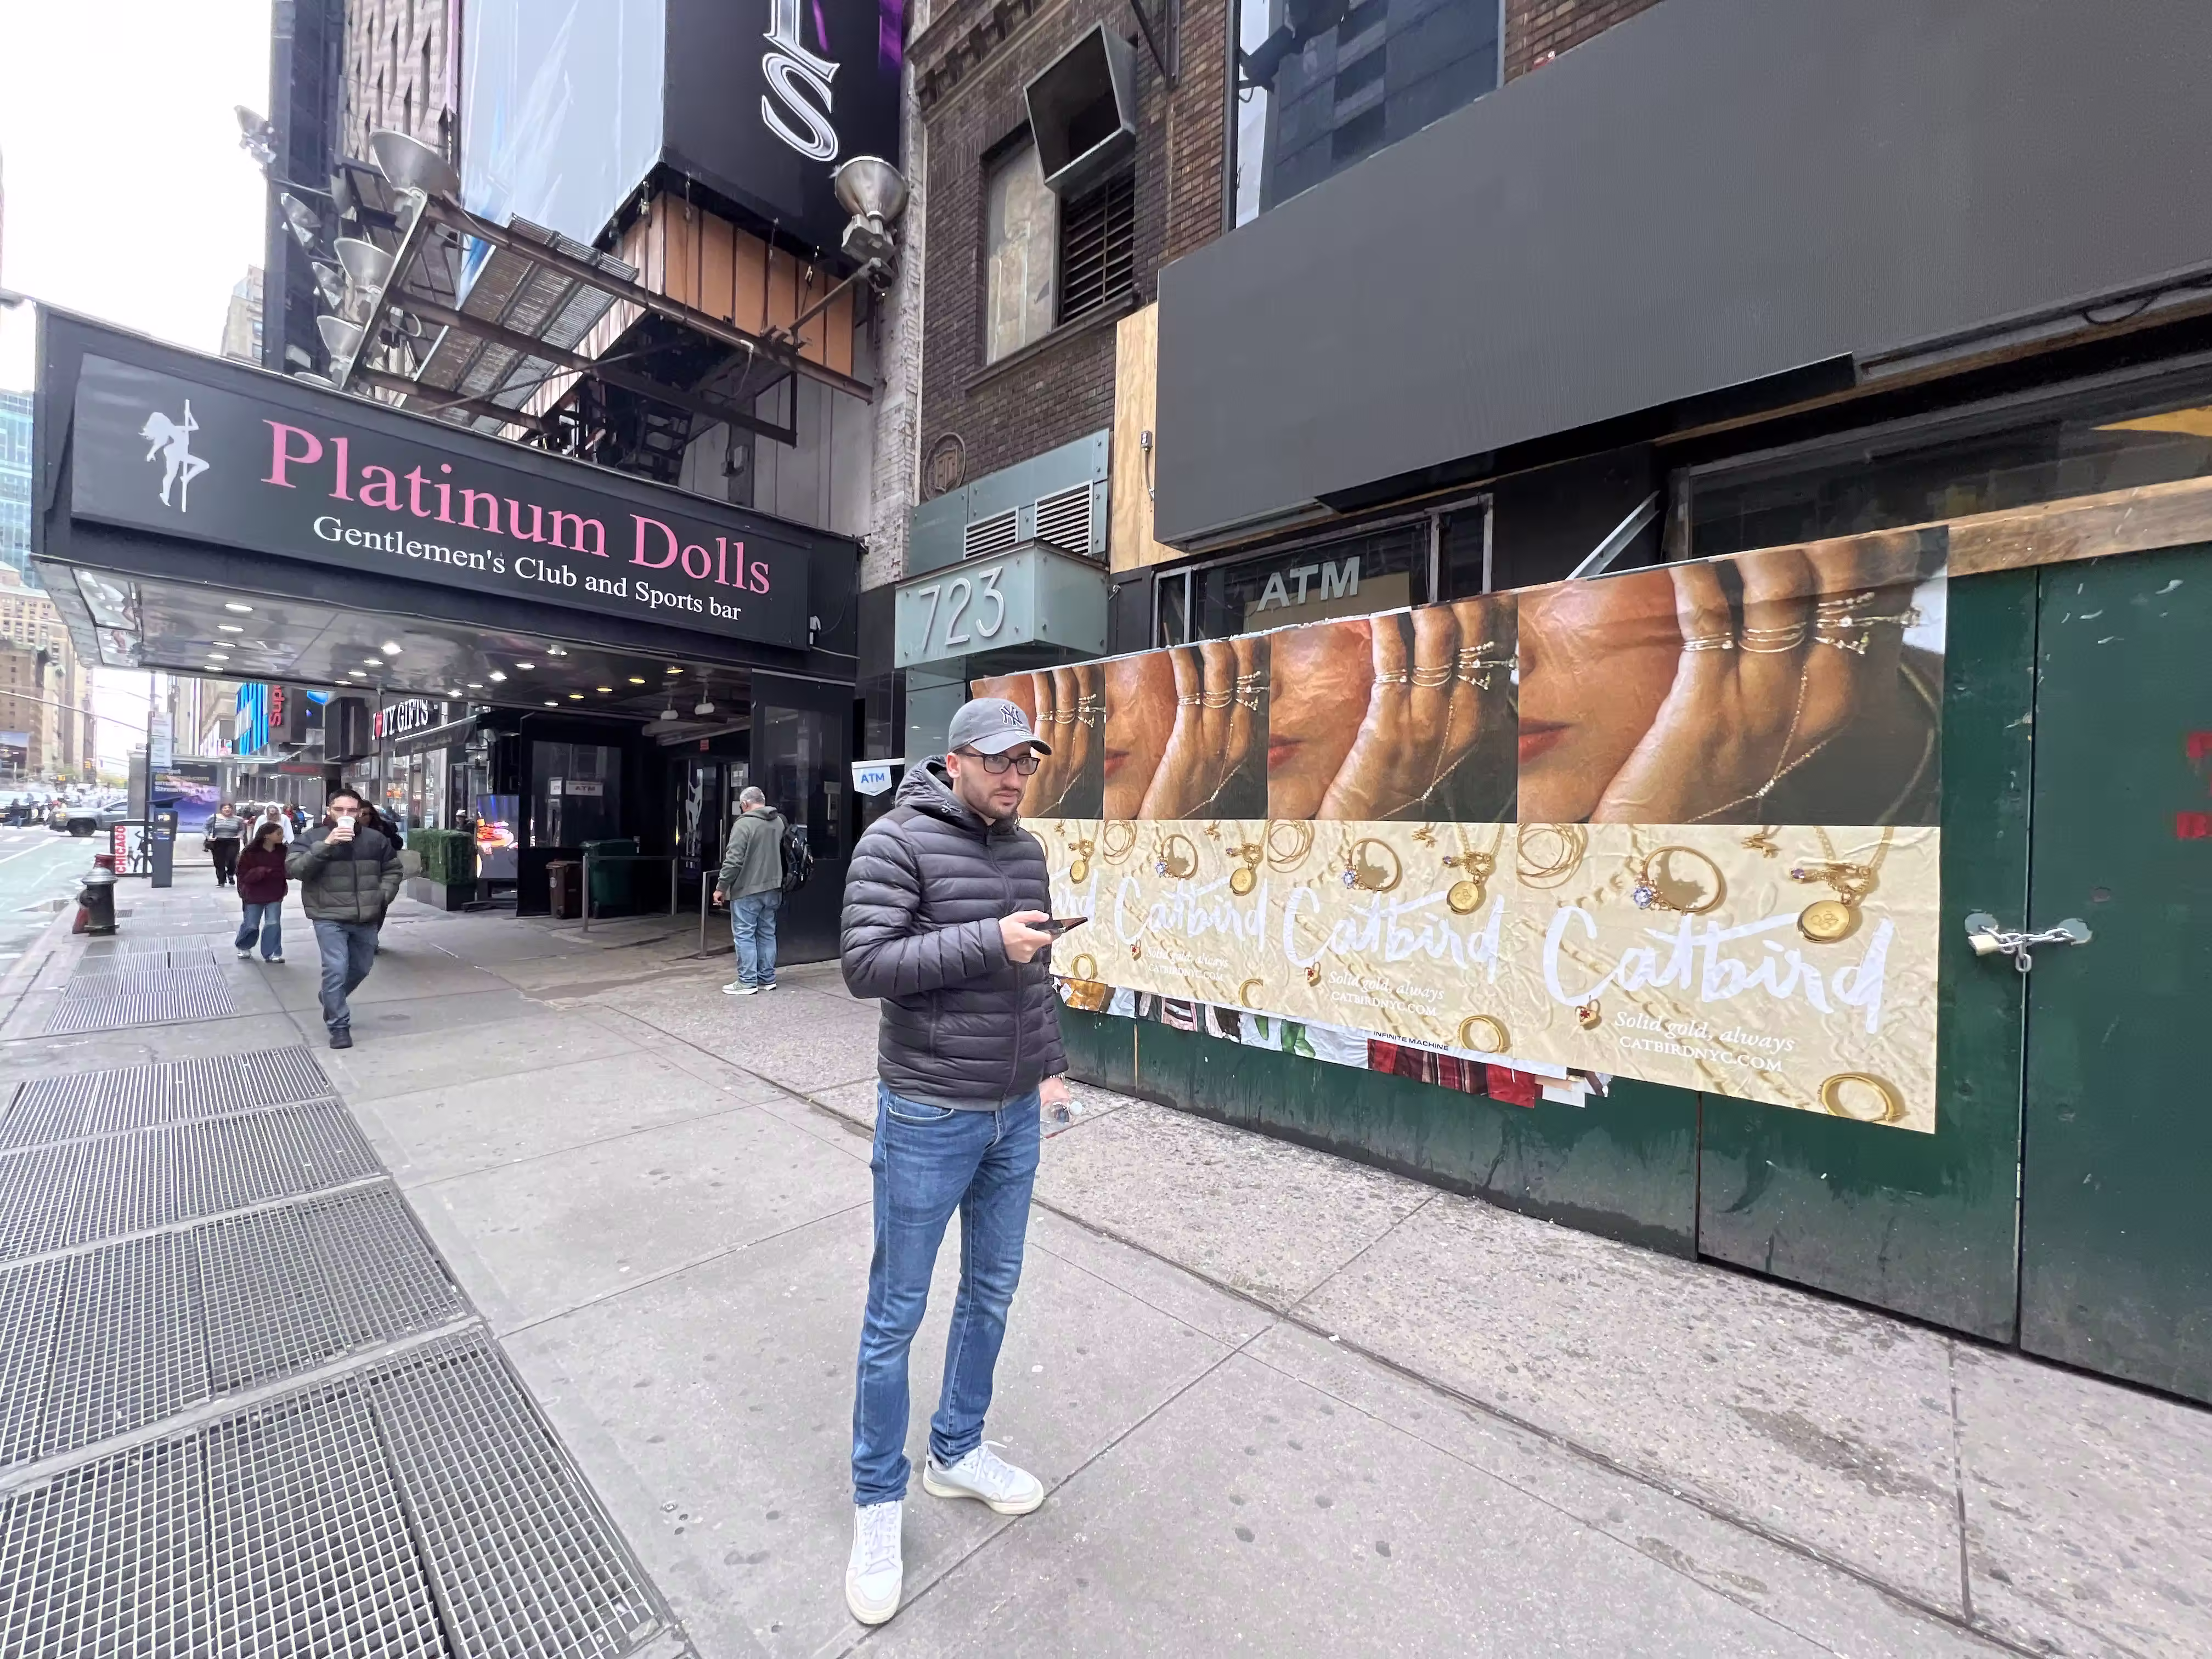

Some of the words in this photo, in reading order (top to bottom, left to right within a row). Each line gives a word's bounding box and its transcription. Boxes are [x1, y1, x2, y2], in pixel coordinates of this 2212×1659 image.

[261, 419, 610, 557] Platinum
[629, 514, 770, 594] Dolls
[313, 516, 506, 574] Gentlemen's
[515, 556, 577, 586] Club
[585, 578, 628, 597] and
[635, 582, 703, 613] Sports
[709, 597, 741, 620] bar
[1256, 556, 1361, 611] ATM
[918, 566, 1005, 651] 723
[397, 698, 428, 732] GIFTS
[1000, 704, 1023, 726] NY
[861, 772, 885, 784] ATM
[1114, 876, 1268, 953] Catbird
[1283, 886, 1505, 984] Catbird
[1148, 963, 1224, 981] CATBIRDNYC.COM
[1195, 953, 1228, 970] always
[1542, 906, 1895, 1034] Catbird
[1328, 971, 1361, 988] Solid
[1360, 977, 1392, 994] gold,
[1396, 979, 1444, 1002] always
[1331, 991, 1437, 1016] CATBIRDNYC.COM
[1373, 1031, 1407, 1042] INFINITE
[1409, 1037, 1449, 1051] MACHINE
[1615, 1011, 1663, 1032] Solid
[1664, 1019, 1713, 1041] gold,
[1719, 1026, 1796, 1054] always
[1620, 1036, 1783, 1073] CATBIRDNYC.COM
